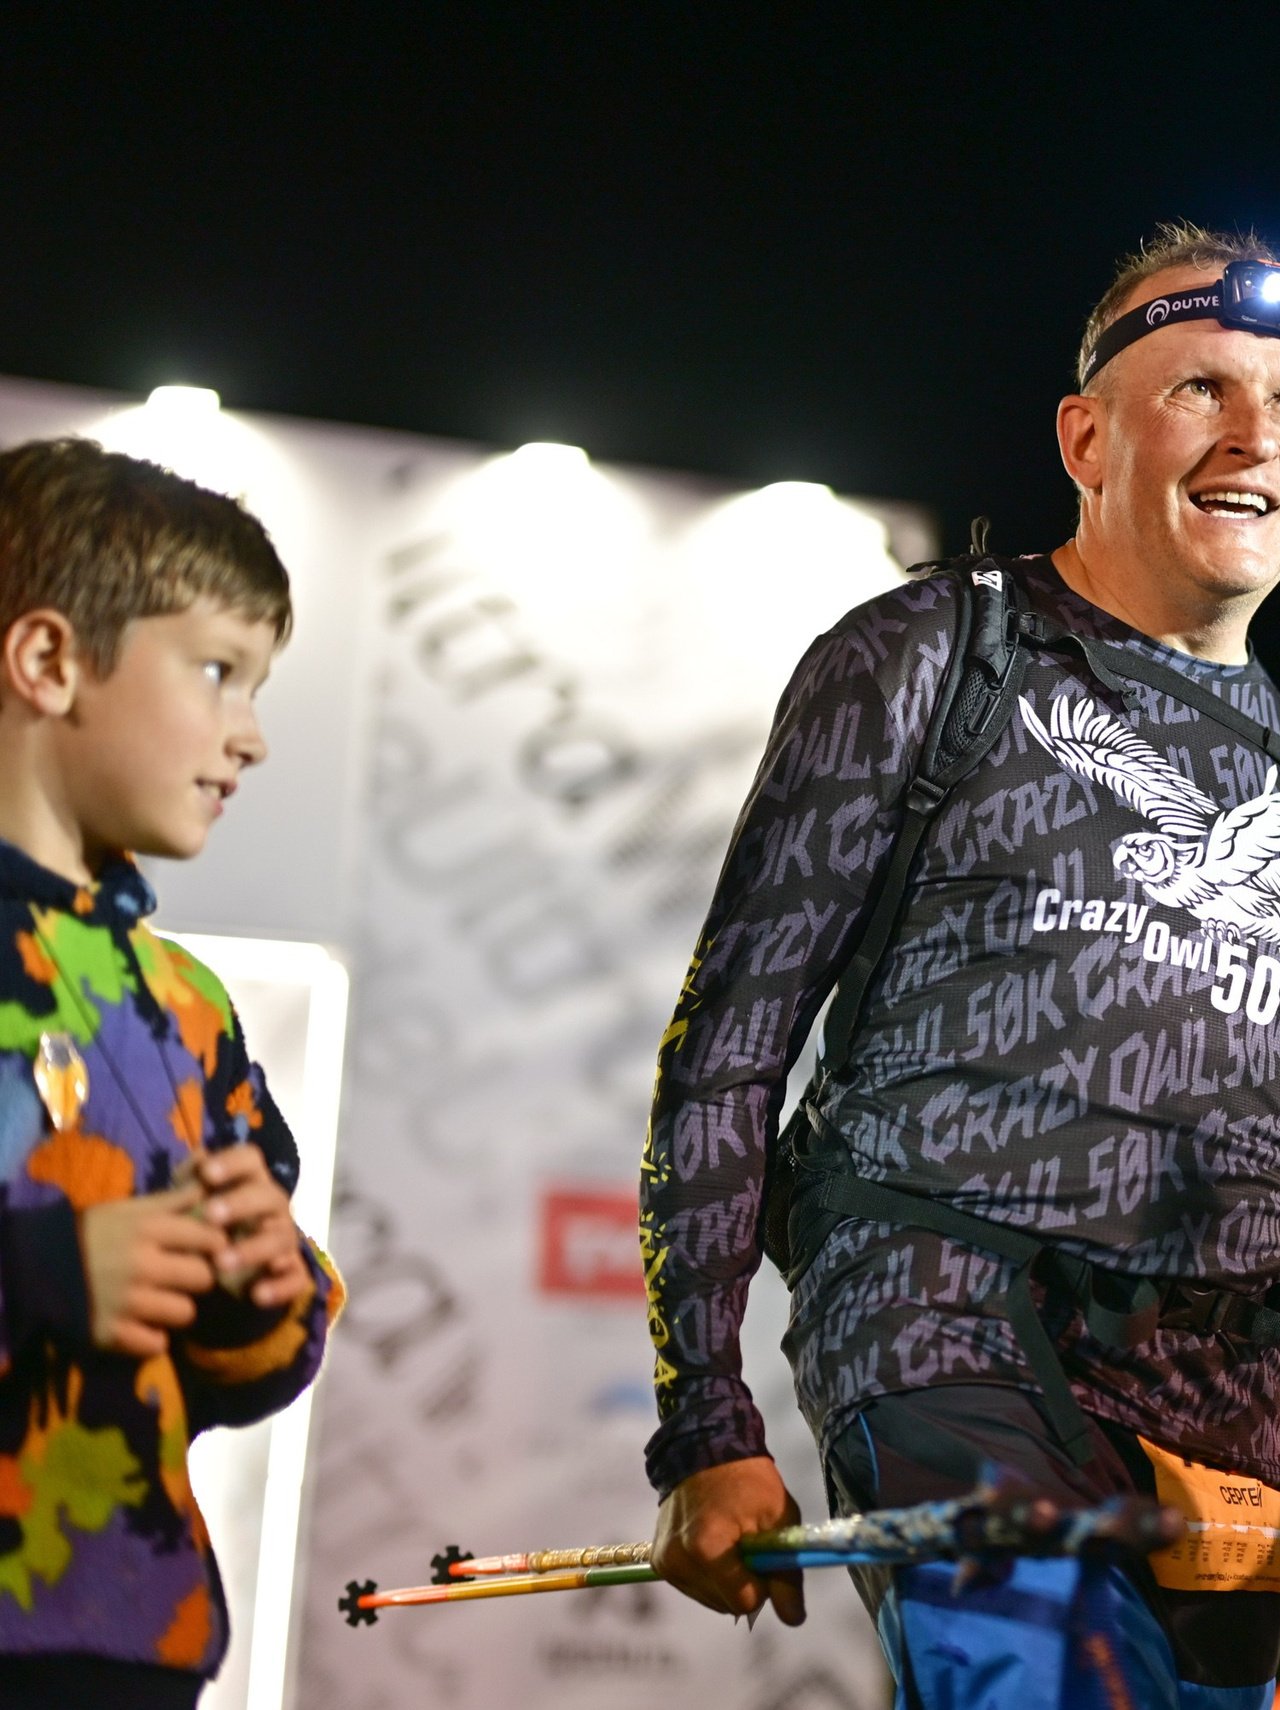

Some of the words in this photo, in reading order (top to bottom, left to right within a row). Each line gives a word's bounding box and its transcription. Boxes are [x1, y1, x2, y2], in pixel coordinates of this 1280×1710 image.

[1032, 888, 1150, 944] Crazy
[1142, 920, 1212, 974] Owl
[961, 958, 1067, 1062] 50K
[916, 1044, 1100, 1166] CRAZY
[1109, 1017, 1220, 1114] OWL
[952, 1154, 1077, 1230] OWL
[1081, 1122, 1187, 1220] 50K
[1219, 1483, 1263, 1508] СЕРГЕЙ
